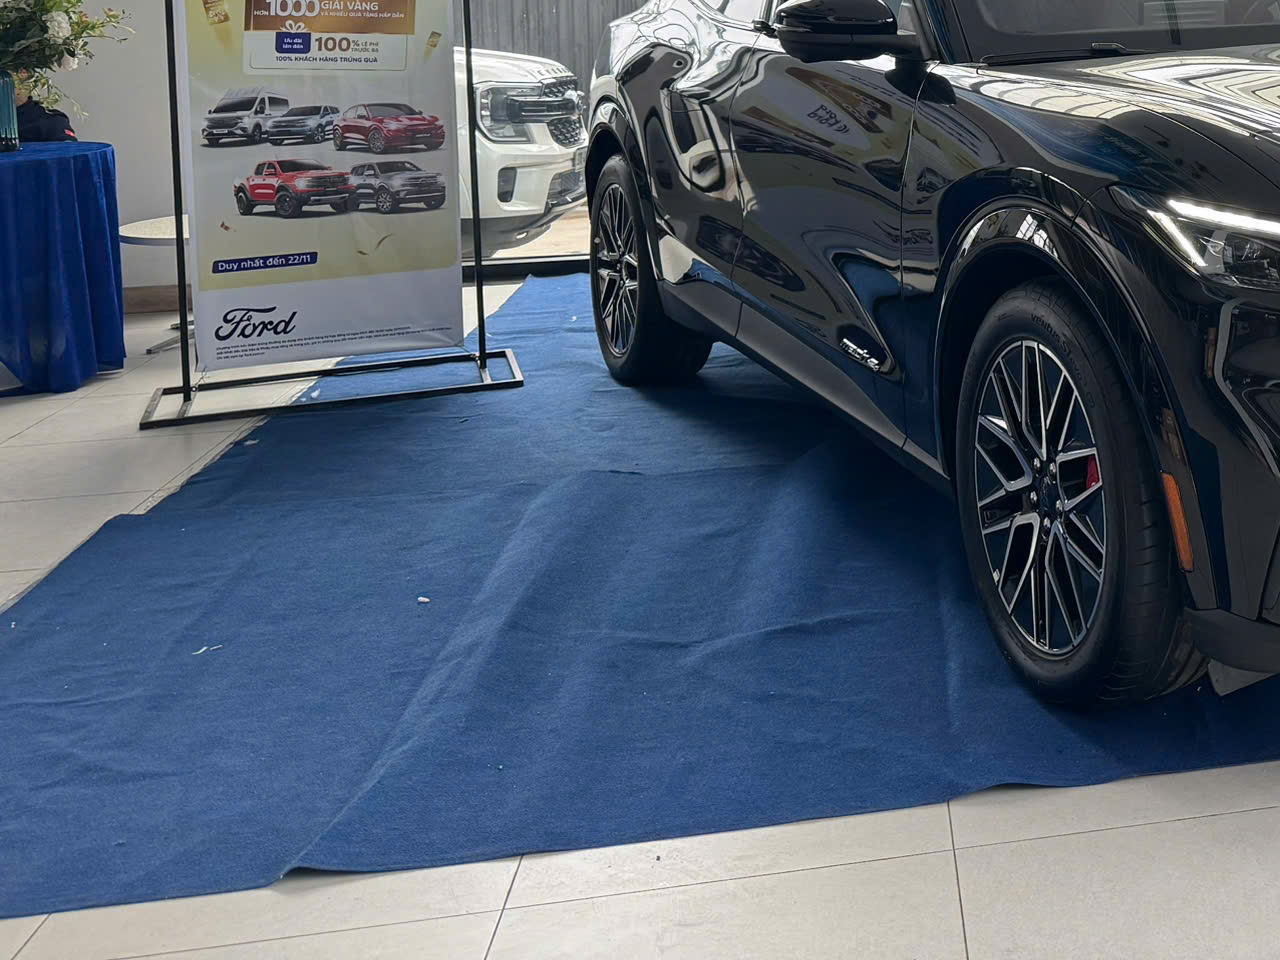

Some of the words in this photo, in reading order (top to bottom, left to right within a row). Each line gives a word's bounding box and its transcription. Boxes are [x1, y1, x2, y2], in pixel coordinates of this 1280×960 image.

[347, 0, 379, 11] VÀNG
[218, 262, 239, 271] Duy
[241, 259, 264, 268] nhất
[266, 256, 286, 266] đến
[288, 254, 311, 263] 22/11
[214, 306, 298, 341] Ford
